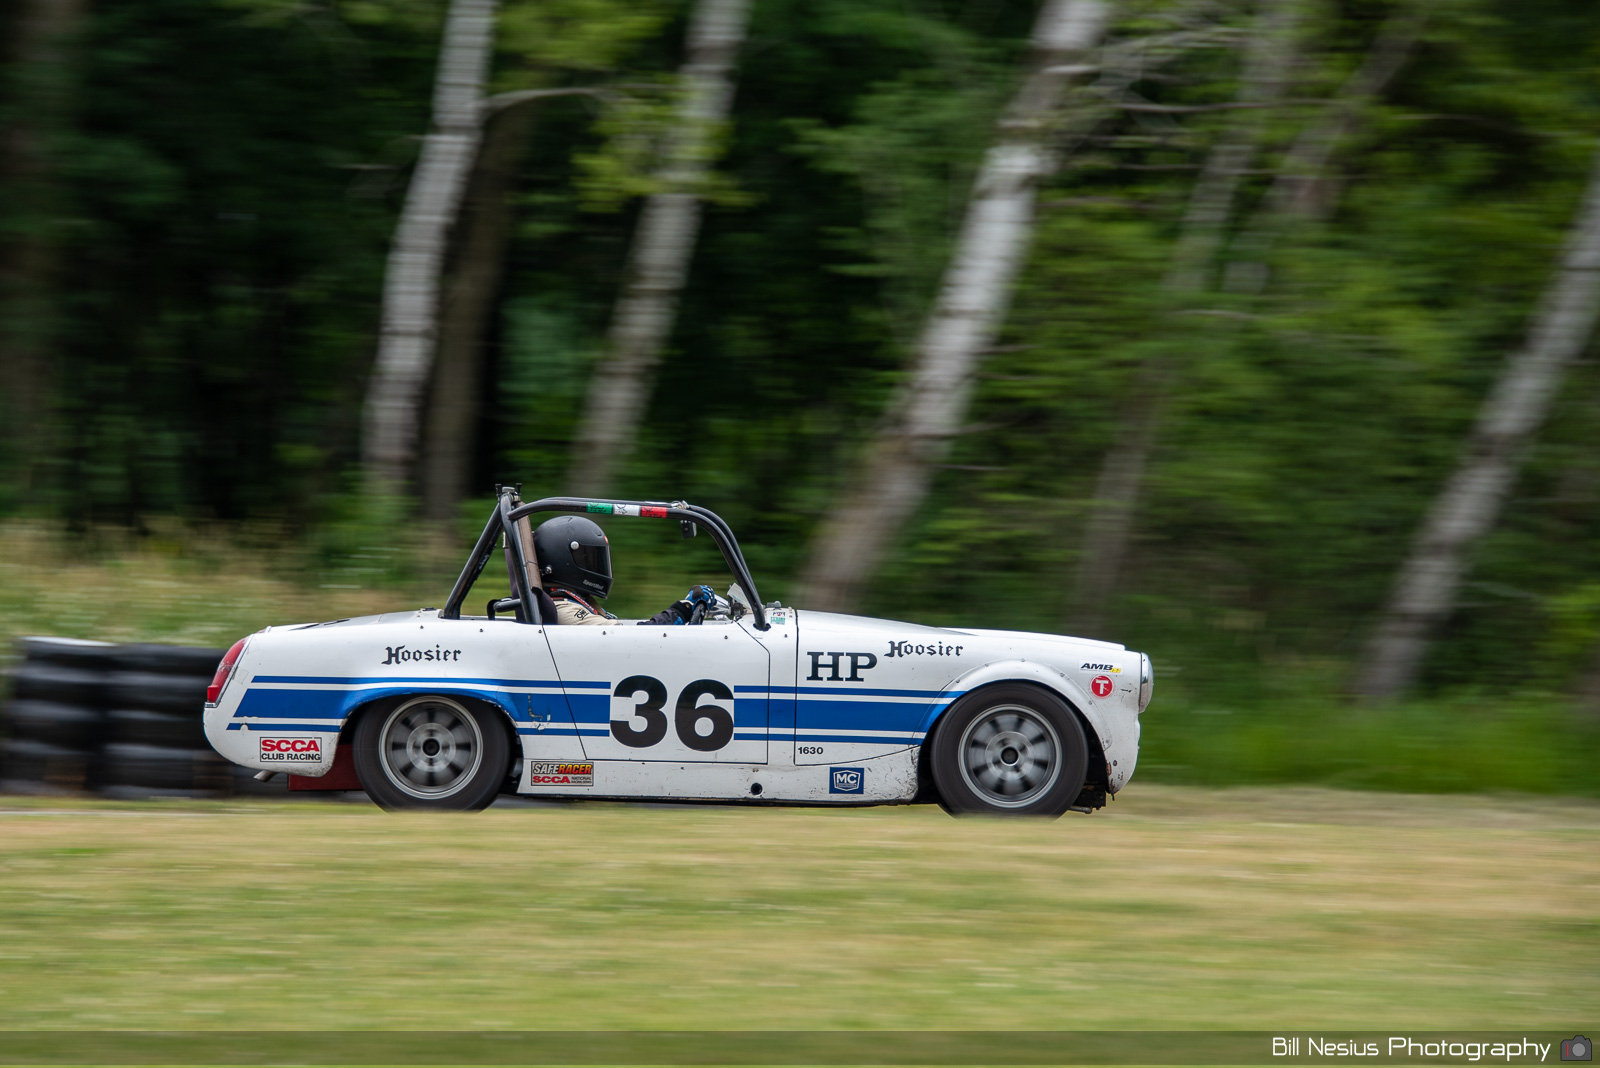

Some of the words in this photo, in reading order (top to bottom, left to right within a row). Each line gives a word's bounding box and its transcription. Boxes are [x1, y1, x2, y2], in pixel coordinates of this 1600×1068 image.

[381, 644, 462, 665] Hoosier
[884, 640, 964, 658] Hoosier
[806, 652, 878, 682] HP
[1081, 663, 1114, 671] AMB
[1095, 680, 1109, 695] T
[610, 675, 734, 752] 36
[261, 739, 320, 752] SCCA
[798, 746, 824, 755] 1630
[261, 753, 286, 761] CLUB
[287, 753, 321, 761] RACING
[836, 773, 857, 784] MC
